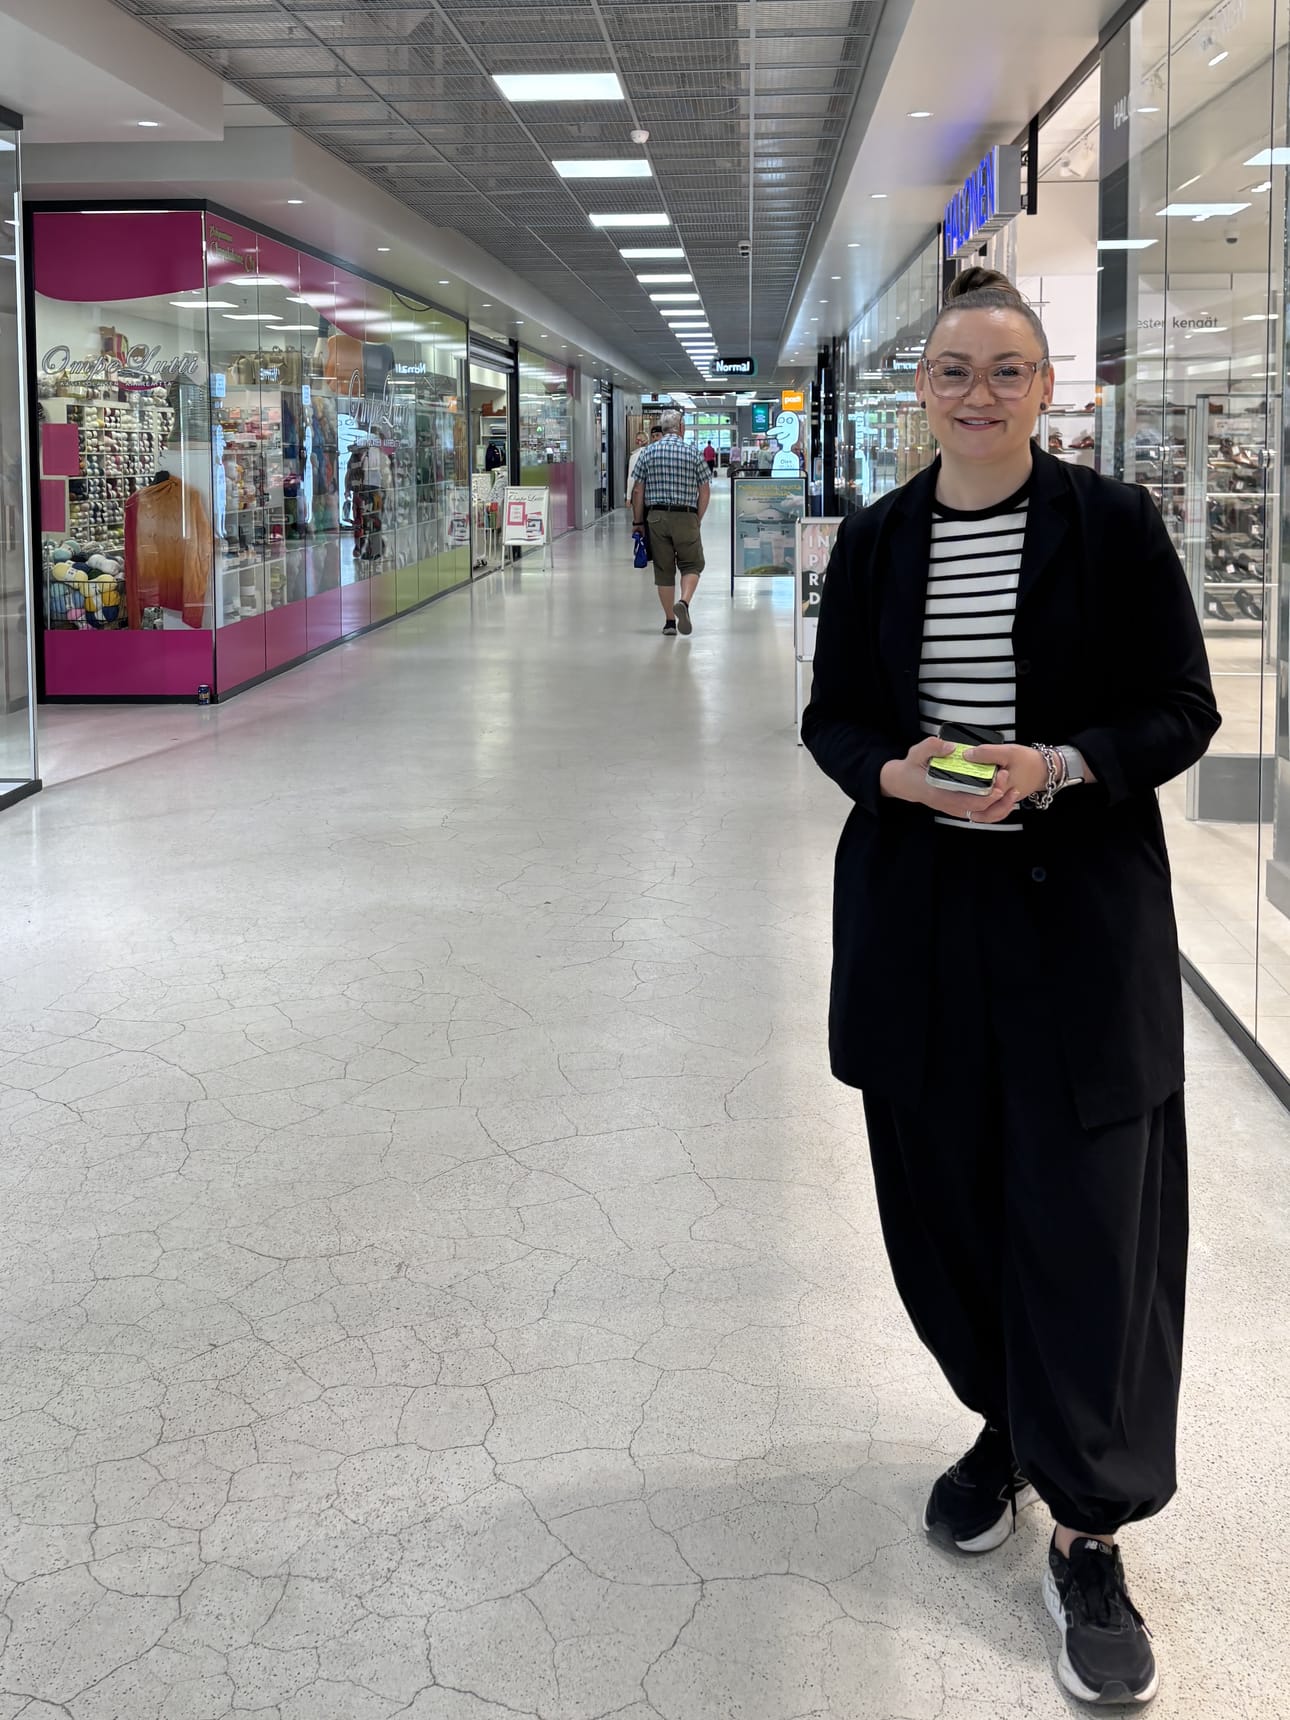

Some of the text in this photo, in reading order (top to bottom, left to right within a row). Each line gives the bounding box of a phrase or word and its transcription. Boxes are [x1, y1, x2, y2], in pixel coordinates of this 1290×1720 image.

[944, 144, 996, 257] HALONEN
[42, 344, 199, 381] Ompe Lutti
[715, 361, 751, 373] Normal
[808, 535, 837, 548] IN
